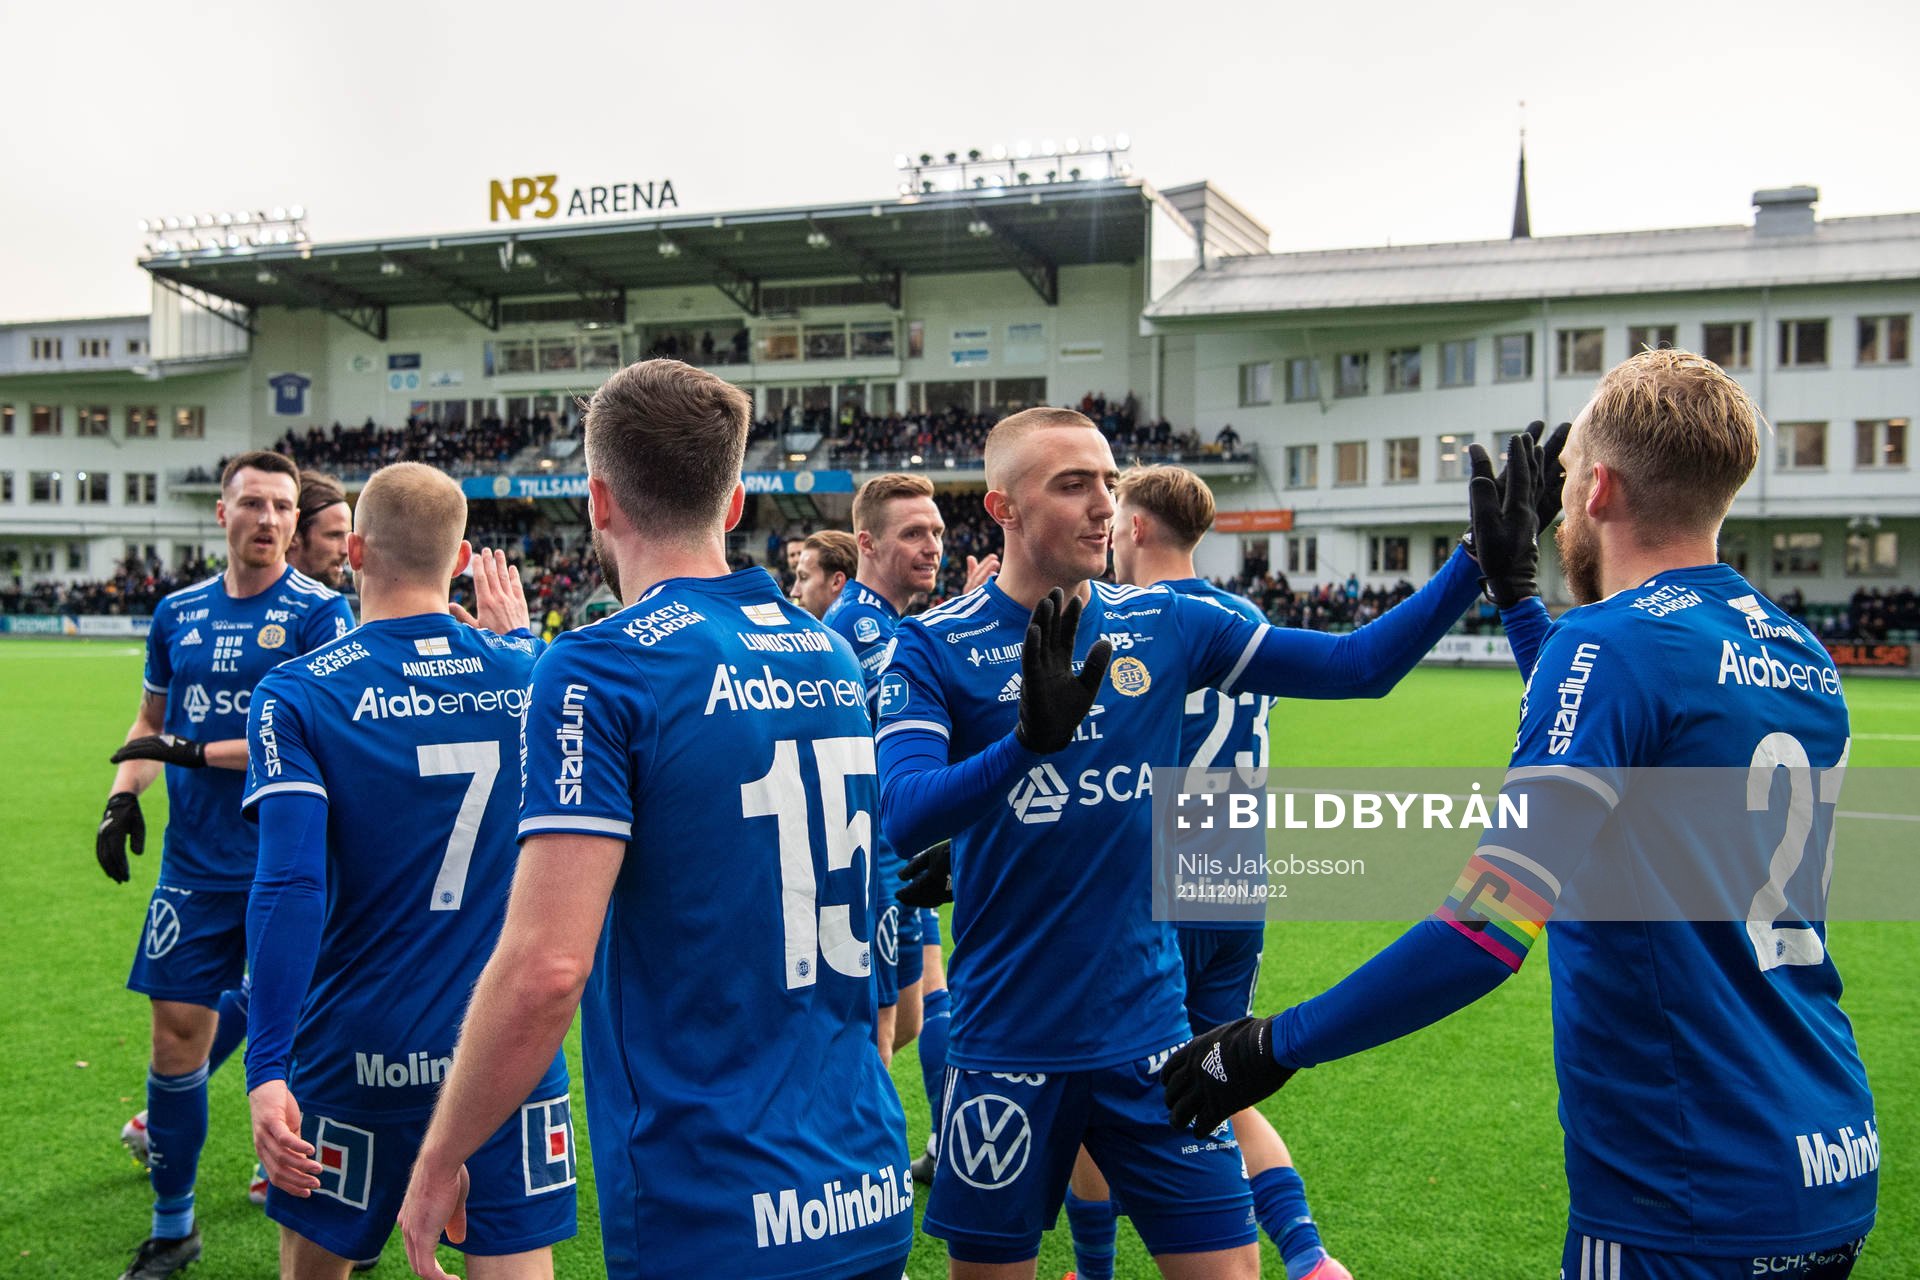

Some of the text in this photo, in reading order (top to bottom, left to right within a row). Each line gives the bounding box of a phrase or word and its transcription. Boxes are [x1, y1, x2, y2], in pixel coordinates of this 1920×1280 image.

[490, 174, 678, 222] NP3 ARENA
[519, 476, 783, 495] TILLSAM RNA
[737, 628, 833, 653] LUNDSTRÖM
[955, 620, 1000, 640] consembly
[402, 656, 483, 678] ANDERSSON
[215, 690, 251, 715] SC
[1547, 643, 1600, 755] stadium
[259, 699, 281, 777] stadium
[555, 684, 588, 805] stadium
[1071, 721, 1104, 742] LL
[1183, 688, 1270, 794] 23
[417, 740, 500, 911] 7
[741, 736, 877, 990] 15
[1213, 1041, 1228, 1083] adidas
[753, 1165, 914, 1248] Molinbil.s
